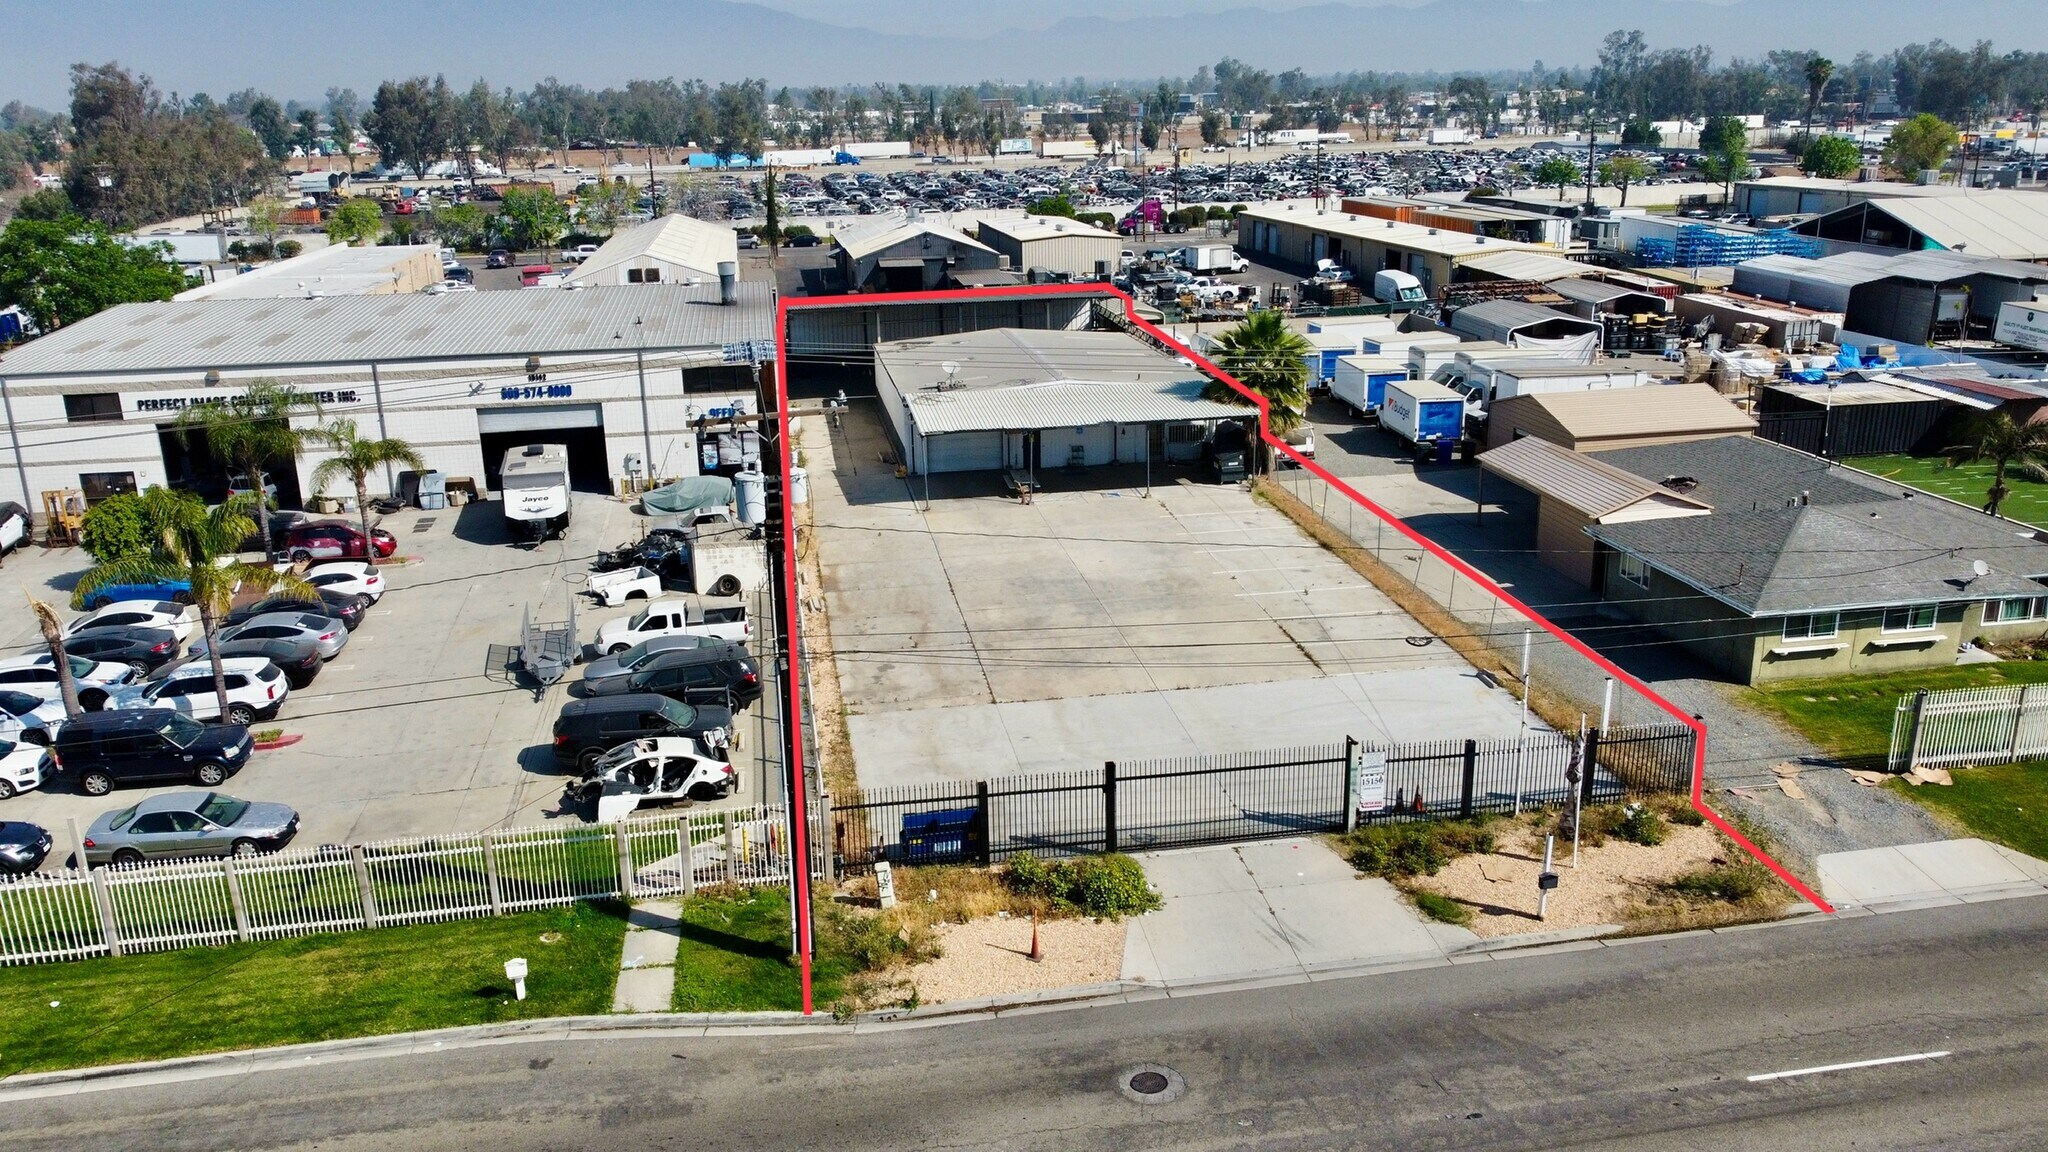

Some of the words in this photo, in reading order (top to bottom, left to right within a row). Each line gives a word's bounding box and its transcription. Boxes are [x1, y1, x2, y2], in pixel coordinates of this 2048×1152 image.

[137, 397, 187, 412] PERFECT
[337, 390, 362, 403] INC.
[1394, 401, 1410, 420] Budget
